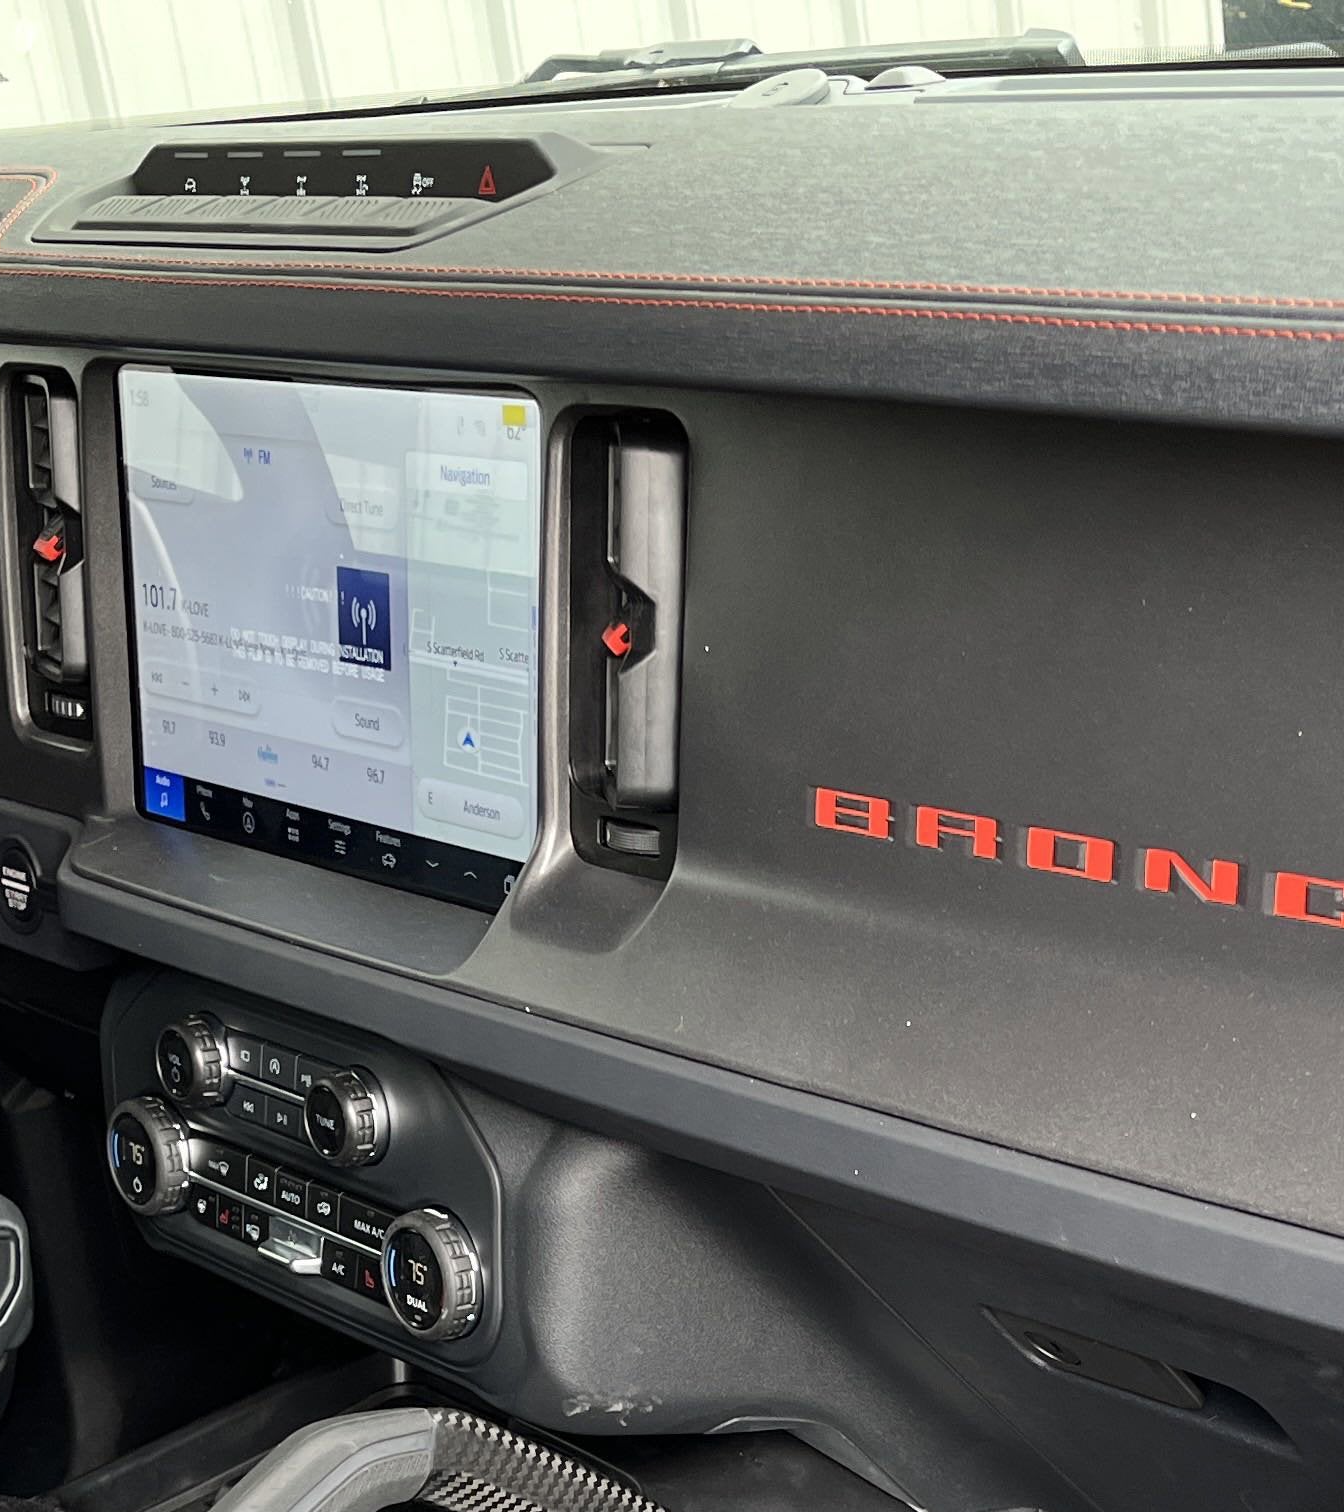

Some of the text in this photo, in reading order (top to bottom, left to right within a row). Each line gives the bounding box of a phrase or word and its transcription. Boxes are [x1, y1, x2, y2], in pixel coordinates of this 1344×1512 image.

[258, 450, 272, 465] FM
[440, 464, 491, 487] Navigation
[364, 499, 384, 517] Tune
[142, 583, 177, 610] 101.7
[474, 649, 485, 663] Rd
[355, 713, 380, 731] Sound
[312, 754, 329, 772] 94.7
[464, 800, 501, 821] Anderson
[315, 1113, 335, 1131] TUNE
[281, 1190, 301, 1205] AUTO
[354, 1219, 385, 1240] MAX A/C
[331, 1262, 345, 1276] A/C
[407, 1294, 428, 1313] DUAL
